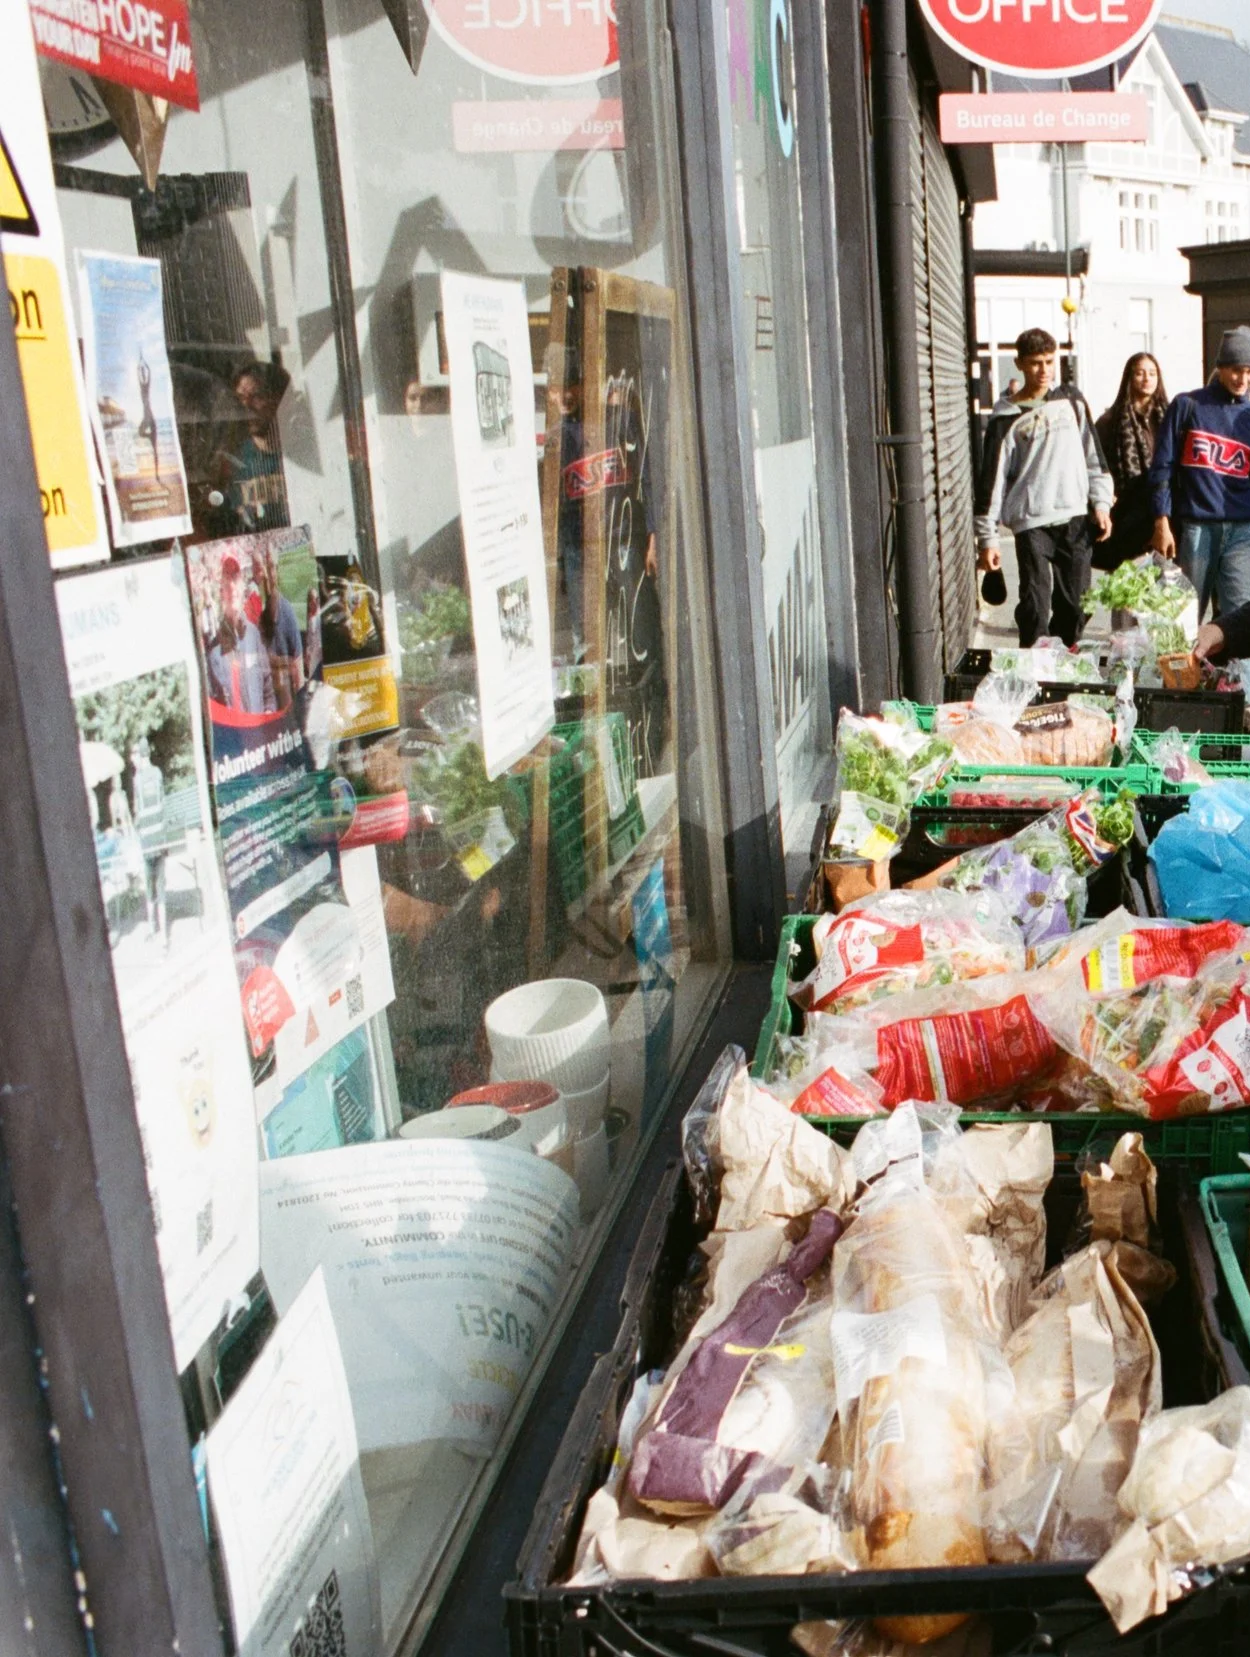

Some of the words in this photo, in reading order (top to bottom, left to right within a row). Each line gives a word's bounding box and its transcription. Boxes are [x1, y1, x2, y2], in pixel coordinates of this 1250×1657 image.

[947, 0, 1129, 23] OFFICE
[956, 109, 1027, 129] Bureau
[1032, 108, 1056, 129] de
[1061, 108, 1132, 131] Change
[1192, 438, 1250, 471] FILA
